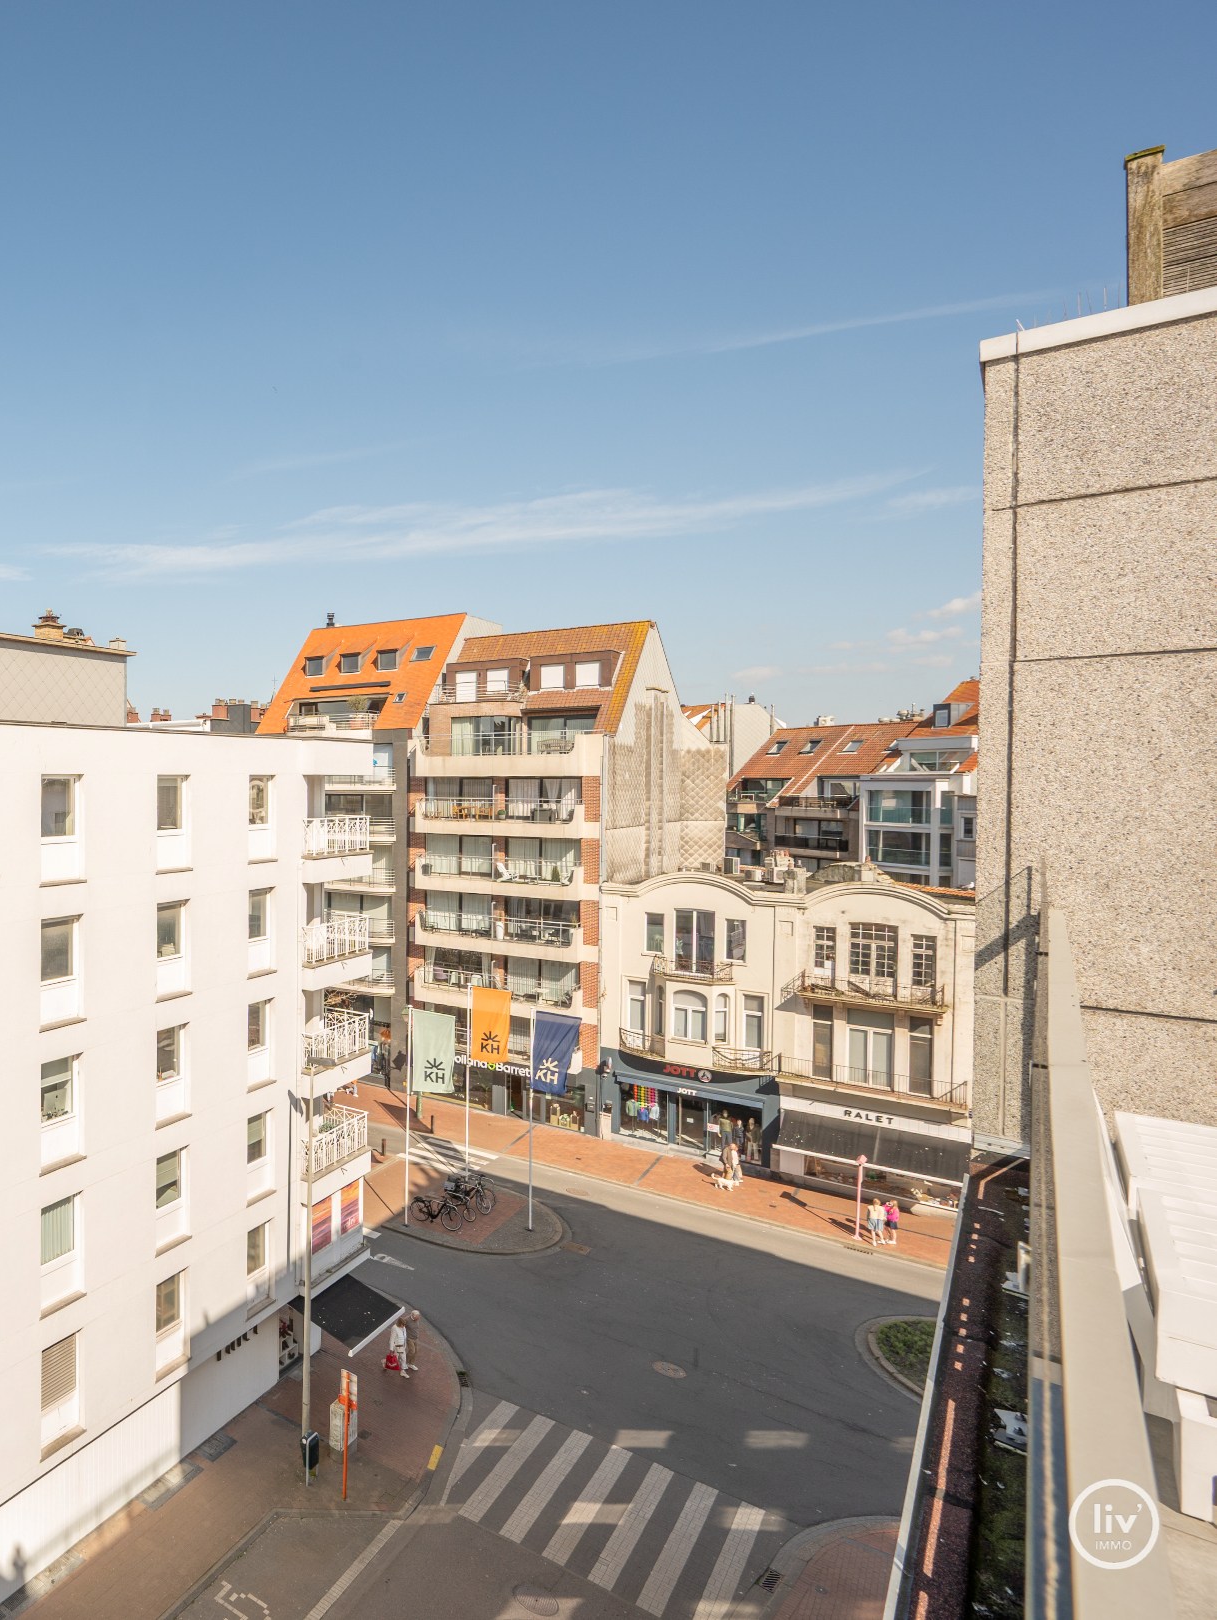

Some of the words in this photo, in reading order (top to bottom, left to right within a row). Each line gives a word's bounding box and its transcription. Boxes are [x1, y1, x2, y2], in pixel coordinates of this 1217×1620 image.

[480, 1042, 500, 1055] KH
[424, 1071, 445, 1085] KH
[535, 1069, 558, 1085] KH
[663, 1064, 696, 1078] JOTT
[677, 1087, 697, 1096] JOTT
[844, 1109, 894, 1125] RALET
